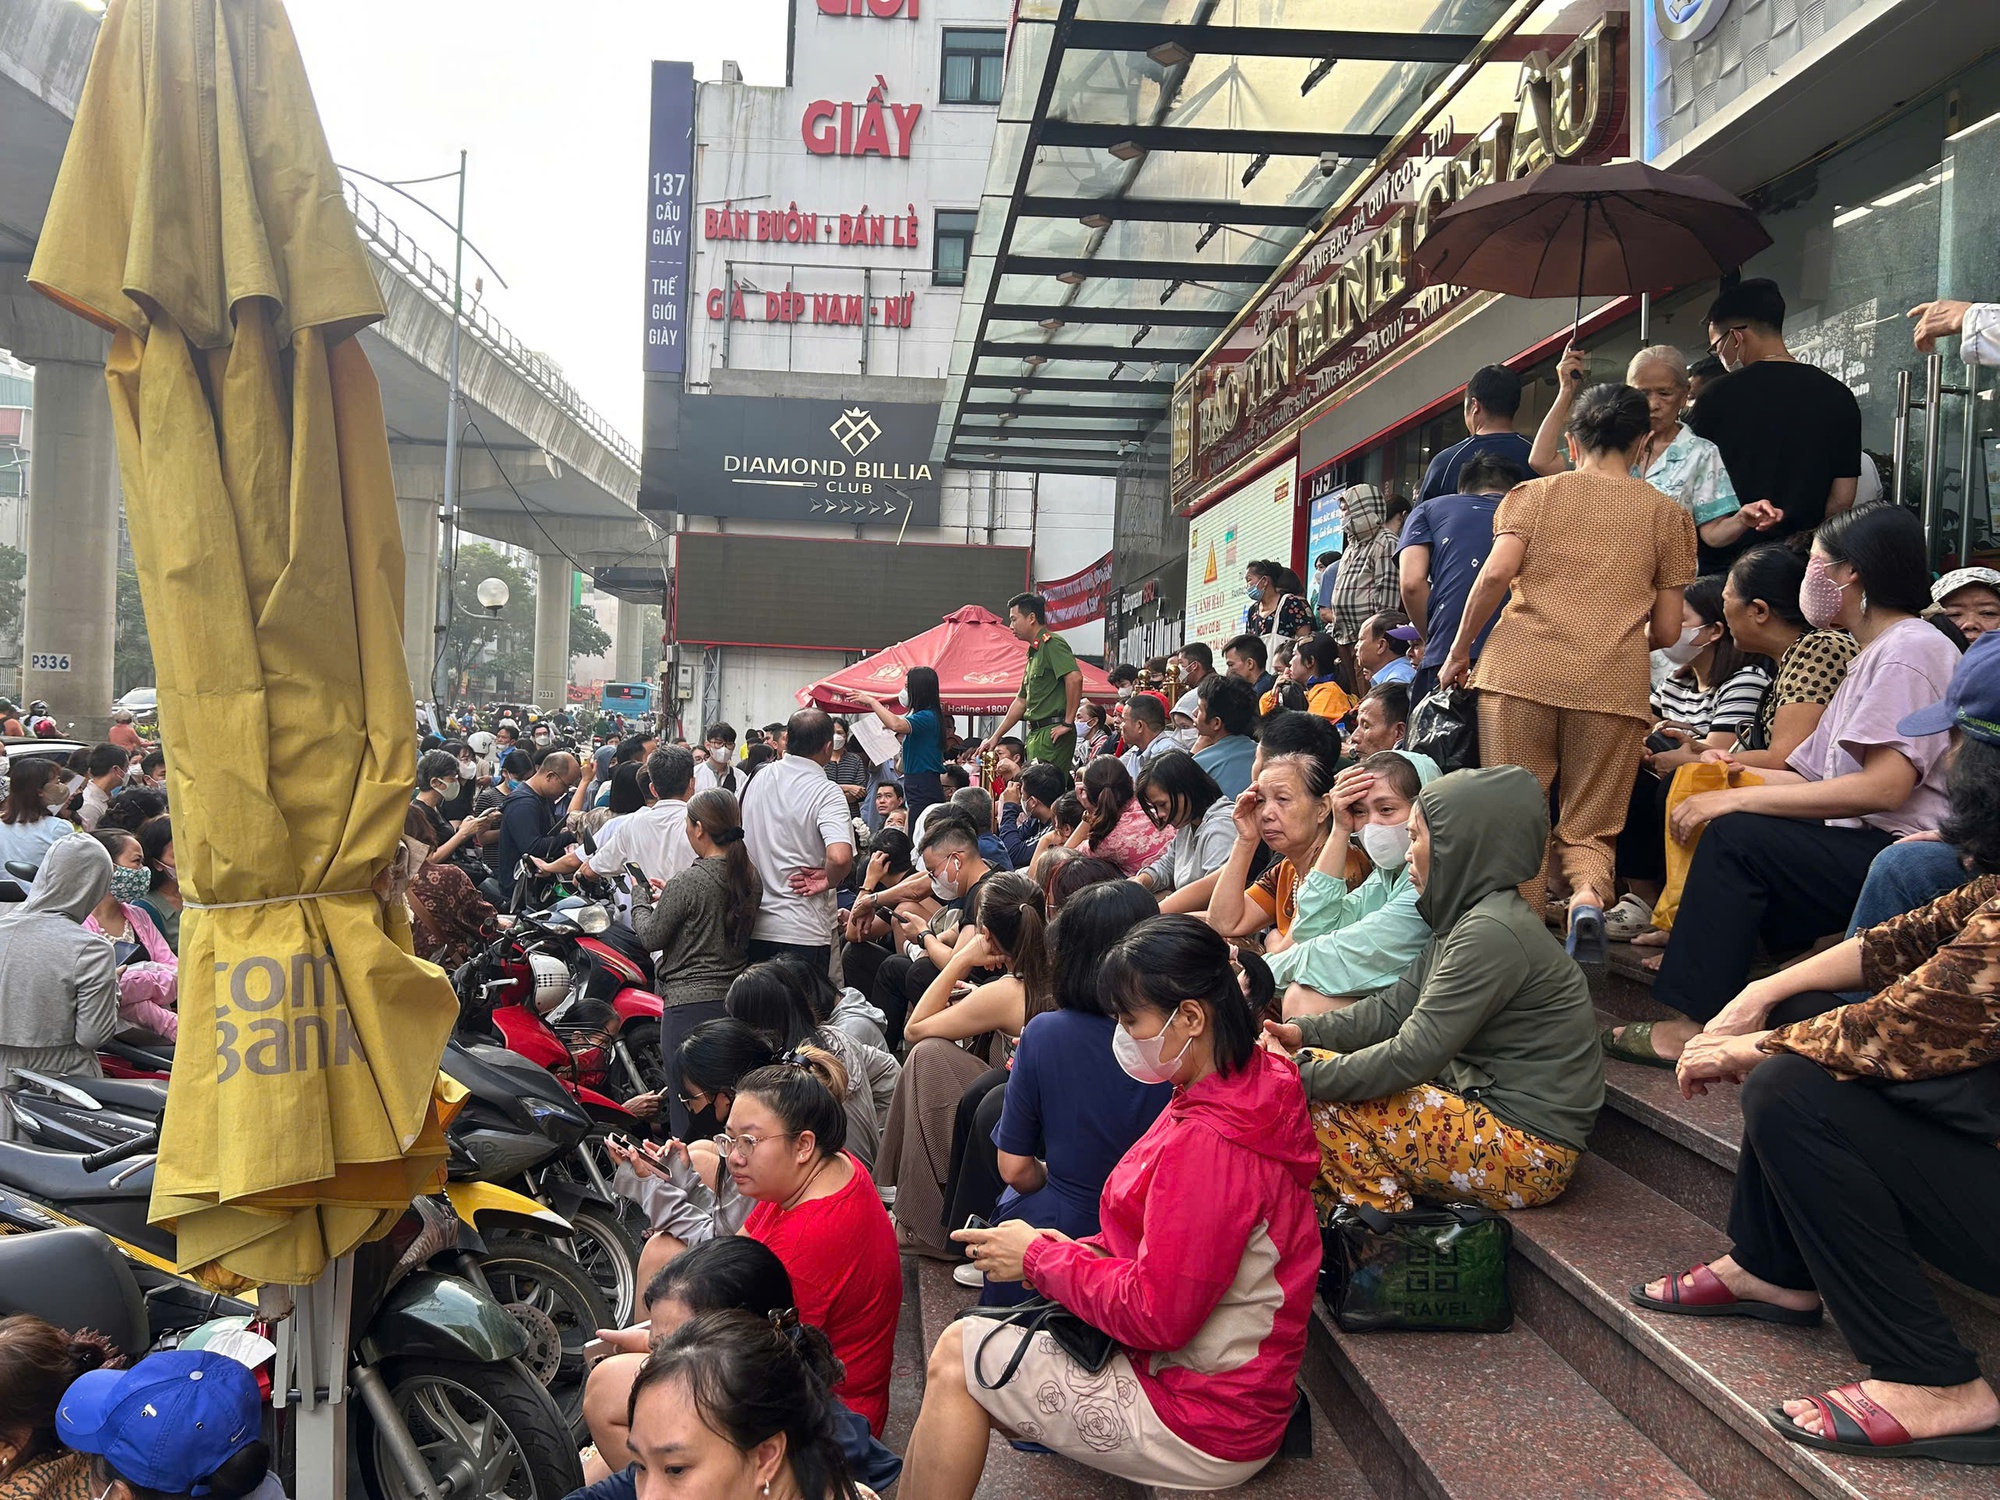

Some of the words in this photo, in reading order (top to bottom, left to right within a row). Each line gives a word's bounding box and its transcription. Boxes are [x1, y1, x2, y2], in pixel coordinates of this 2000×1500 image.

[801, 74, 922, 159] GIẦY
[652, 173, 686, 197] 137
[655, 200, 681, 222] CẦU
[705, 199, 749, 241] BÁN
[757, 201, 817, 243] BUÔN
[839, 204, 885, 246] BÁN
[893, 203, 918, 248] LẺ
[652, 225, 682, 247] GIẤY
[651, 275, 679, 296] THẾ
[651, 302, 677, 321] GIỚI
[766, 282, 806, 323] DÉP
[813, 292, 862, 325] NAM
[648, 325, 678, 346] GIÀY
[1197, 363, 1241, 456] BẢO
[1297, 208, 1406, 374] MINH
[723, 454, 846, 480] DIAMOND
[854, 460, 933, 482] BILLIA
[825, 481, 873, 496] CLUB
[32, 654, 70, 670] P336
[538, 689, 554, 699] P338
[947, 704, 984, 714] Hotline:
[986, 704, 1008, 714] 1800
[1393, 1301, 1475, 1317] TRAVEL
